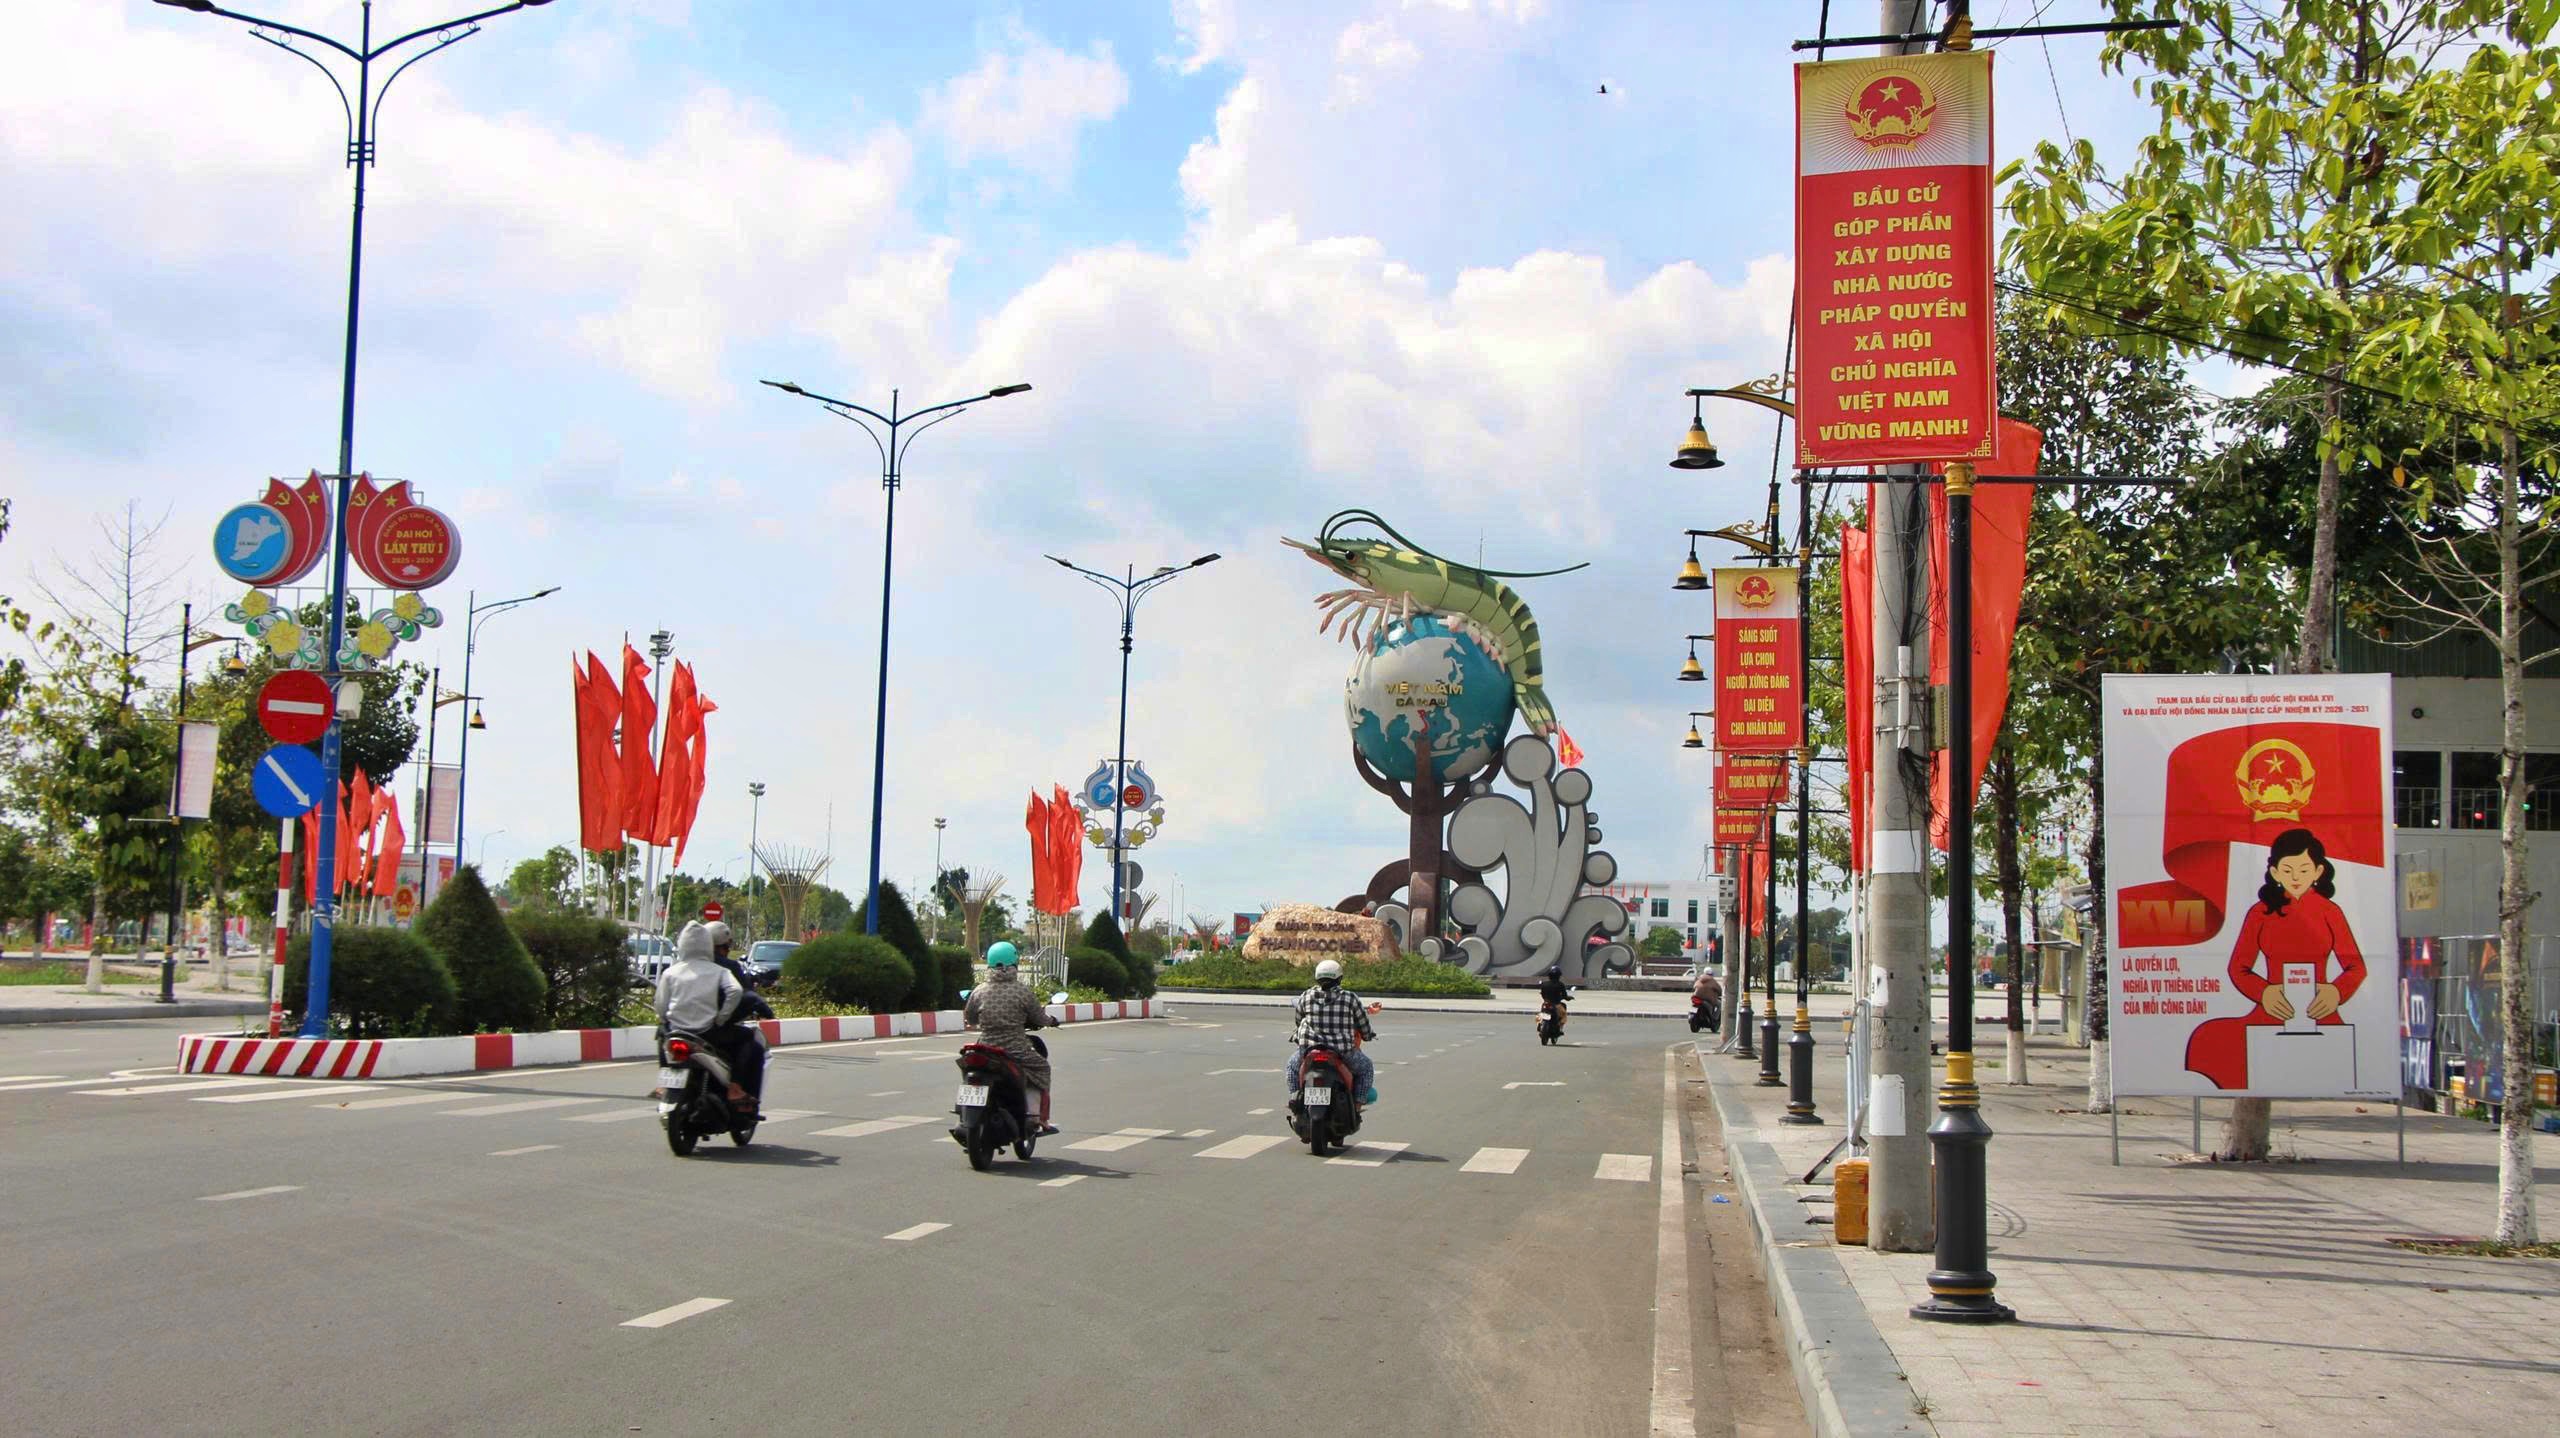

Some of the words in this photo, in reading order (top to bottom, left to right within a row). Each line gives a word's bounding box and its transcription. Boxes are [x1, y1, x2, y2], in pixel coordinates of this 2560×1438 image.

[1853, 183, 1899, 207] BẦU
[1907, 181, 1941, 203] CỬ
[1834, 217, 1879, 237] GÓP
[1887, 210, 1952, 233] PHẦN
[1834, 246, 1878, 266] XÂY
[1886, 243, 1951, 264] DỰNG
[1833, 274, 1880, 295] NHÀ
[1888, 270, 1952, 291] NƯỚC
[1820, 304, 1882, 325] PHÁP
[1889, 297, 1967, 321] QUYỀN
[1854, 331, 1885, 351] XÃ
[1892, 329, 1932, 351] HỘI
[1830, 359, 1877, 382] CHỦ
[1884, 357, 1957, 379] NGHĨA
[1838, 391, 1887, 413] VIỆT
[1894, 389, 1949, 408] NAM
[1819, 421, 1881, 441] VỮNG
[1889, 419, 1969, 440] MẠNH!
[1739, 627, 1758, 643] SÁNG
[1760, 625, 1778, 643] SUỐT
[1740, 651, 1754, 669] LỰA
[1755, 651, 1775, 669] CHỌN
[1424, 683, 1463, 695] NAM
[1726, 672, 1748, 689] NGƯỜI
[1749, 672, 1769, 689] XỨNG
[1770, 672, 1790, 689] ĐÁNG
[1743, 698, 1756, 715] ĐẠI
[1757, 696, 1775, 715] DIỆN
[2122, 706, 2133, 716] VÀ
[2150, 706, 2167, 715] BIỂU
[2170, 707, 2182, 716] HỘI
[2184, 706, 2206, 715] ĐỒNG
[2207, 706, 2229, 715] NHÂN
[2231, 706, 2247, 715] DÂN
[2250, 705, 2265, 714] CÁC
[2267, 704, 2282, 714] CẤP
[2285, 705, 2310, 715] NHIỆM
[2351, 705, 2369, 713] 2031
[2180, 696, 2193, 704] GIA
[2195, 694, 2210, 704] BẦU
[2240, 694, 2258, 703] BIỂU
[2260, 694, 2280, 703] QUỐC
[2283, 694, 2296, 703] HỘI
[2321, 694, 2334, 702] XVI
[1731, 721, 1745, 736] CHO
[1746, 719, 1767, 735] NHÂN
[1768, 719, 1786, 735] DÂN!
[2121, 899, 2206, 933] XVI
[2122, 956, 2133, 972] LÀ
[2135, 953, 2162, 973] QUYỀN
[2165, 957, 2180, 975] LỢI,
[2123, 977, 2149, 993] NGHĨA
[2151, 979, 2161, 996] VỤ
[2164, 977, 2194, 993] THIÊNG
[2196, 977, 2221, 993] LIÊNG
[2123, 995, 2141, 1015] CỦA
[2161, 998, 2184, 1015] CÔNG
[2186, 998, 2207, 1015] DÂN!
